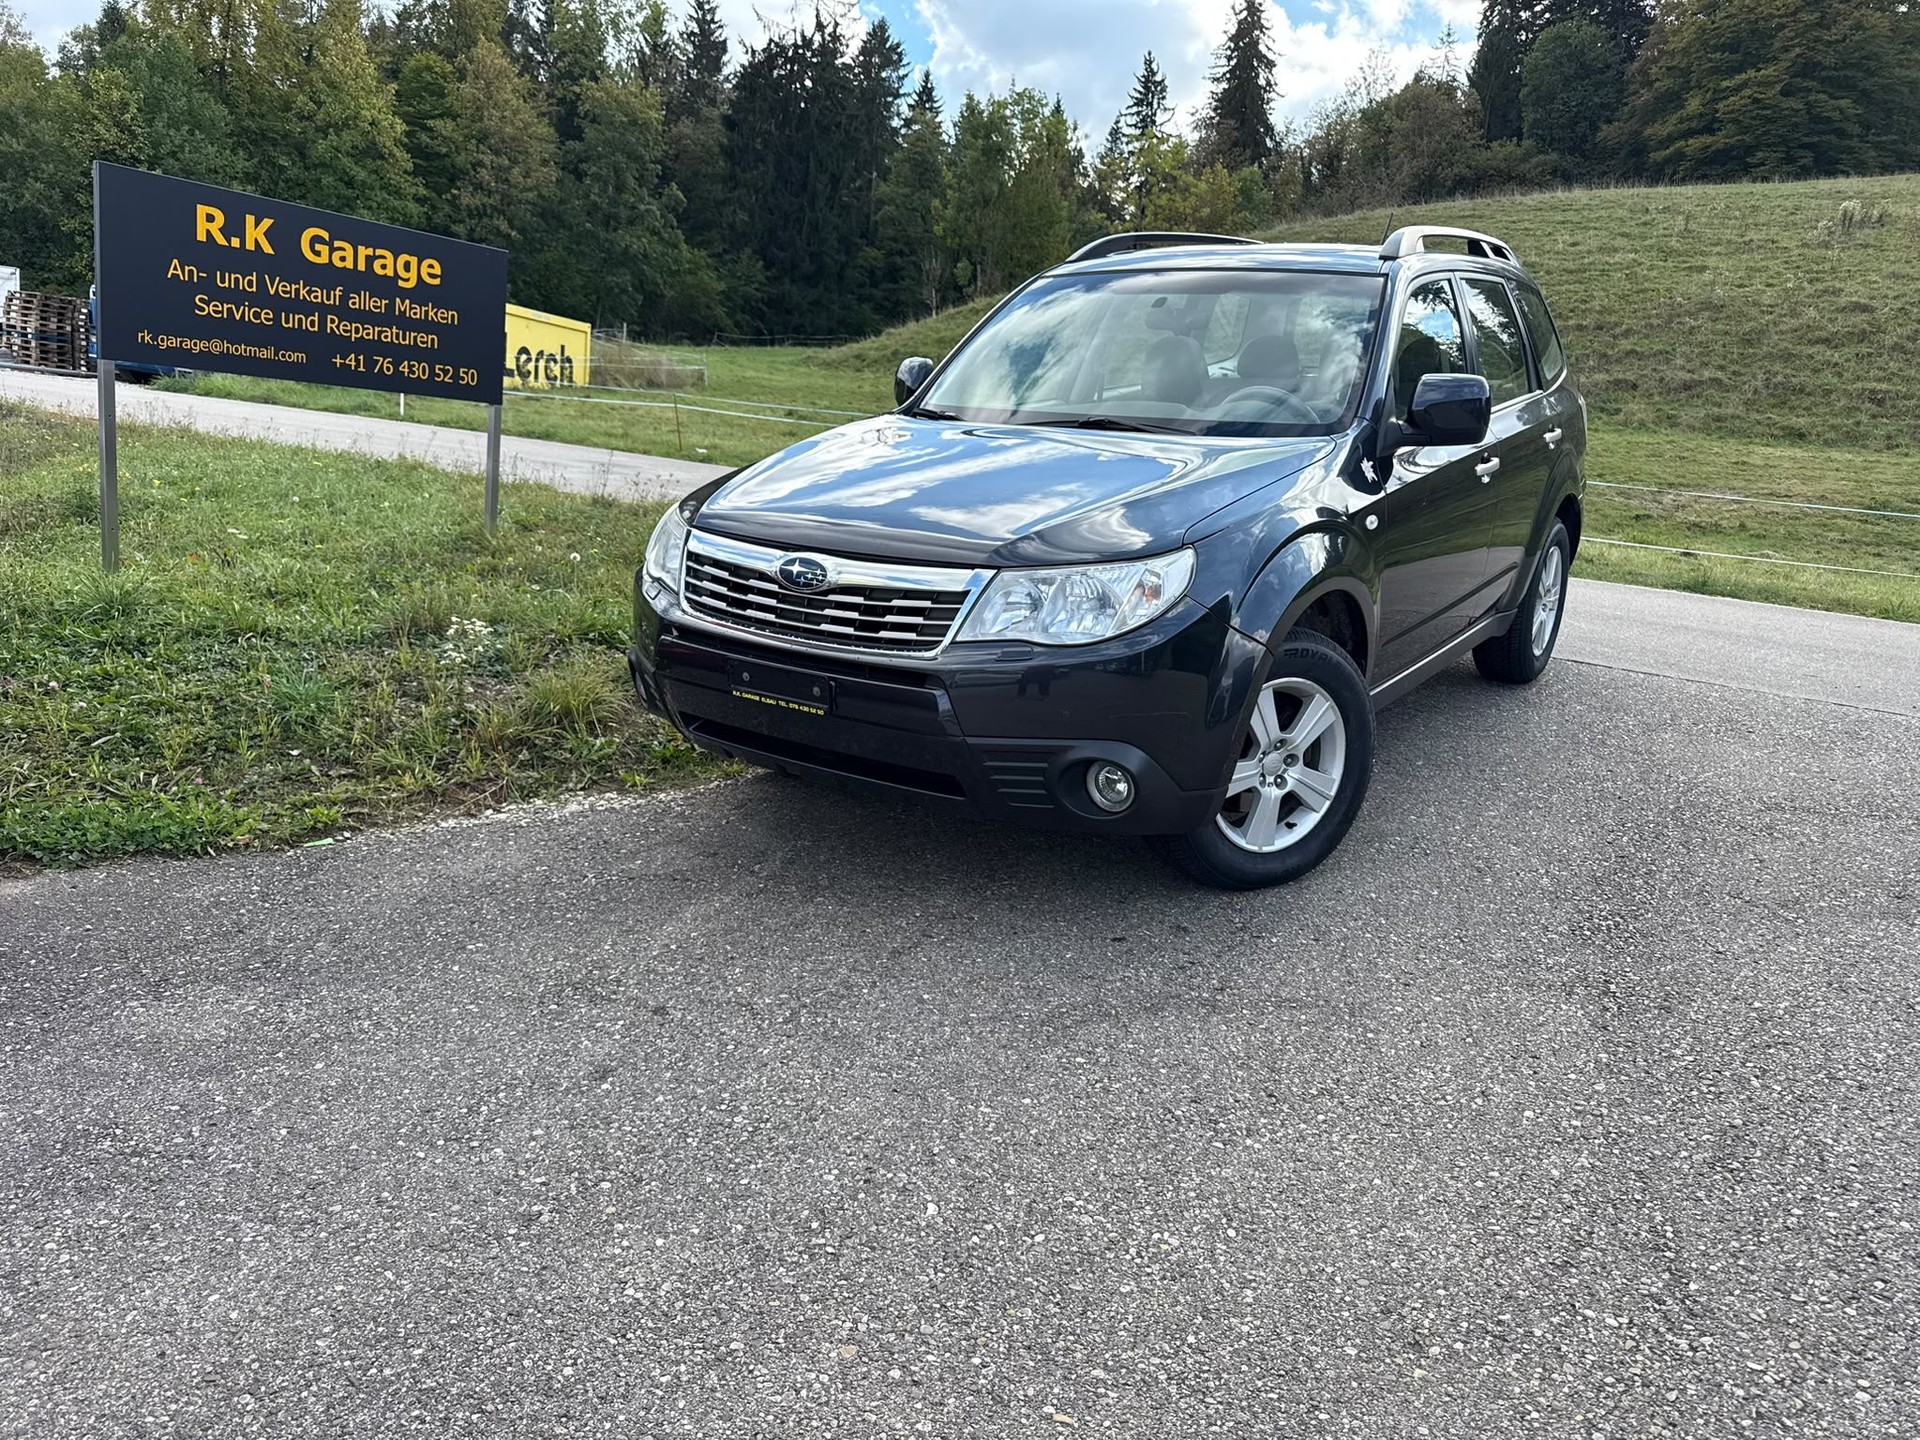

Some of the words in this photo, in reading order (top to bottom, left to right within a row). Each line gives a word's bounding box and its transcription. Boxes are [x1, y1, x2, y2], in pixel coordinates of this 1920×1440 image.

[195, 203, 275, 255] R.K
[300, 227, 443, 289] Garage
[167, 258, 208, 284] An-
[216, 271, 258, 293] und
[265, 274, 343, 307] Verkauf
[348, 290, 388, 315] aller
[395, 297, 459, 326] Marken
[194, 294, 274, 325] Service
[281, 313, 319, 333] und
[326, 315, 439, 349] Reparaturen
[137, 329, 307, 364] rk.garage@hotmail.com
[331, 354, 367, 373] +41
[373, 355, 394, 376] 76
[399, 358, 430, 381] 430
[434, 363, 455, 384] 52
[459, 366, 479, 387] 50
[742, 692, 760, 701] GARAGE
